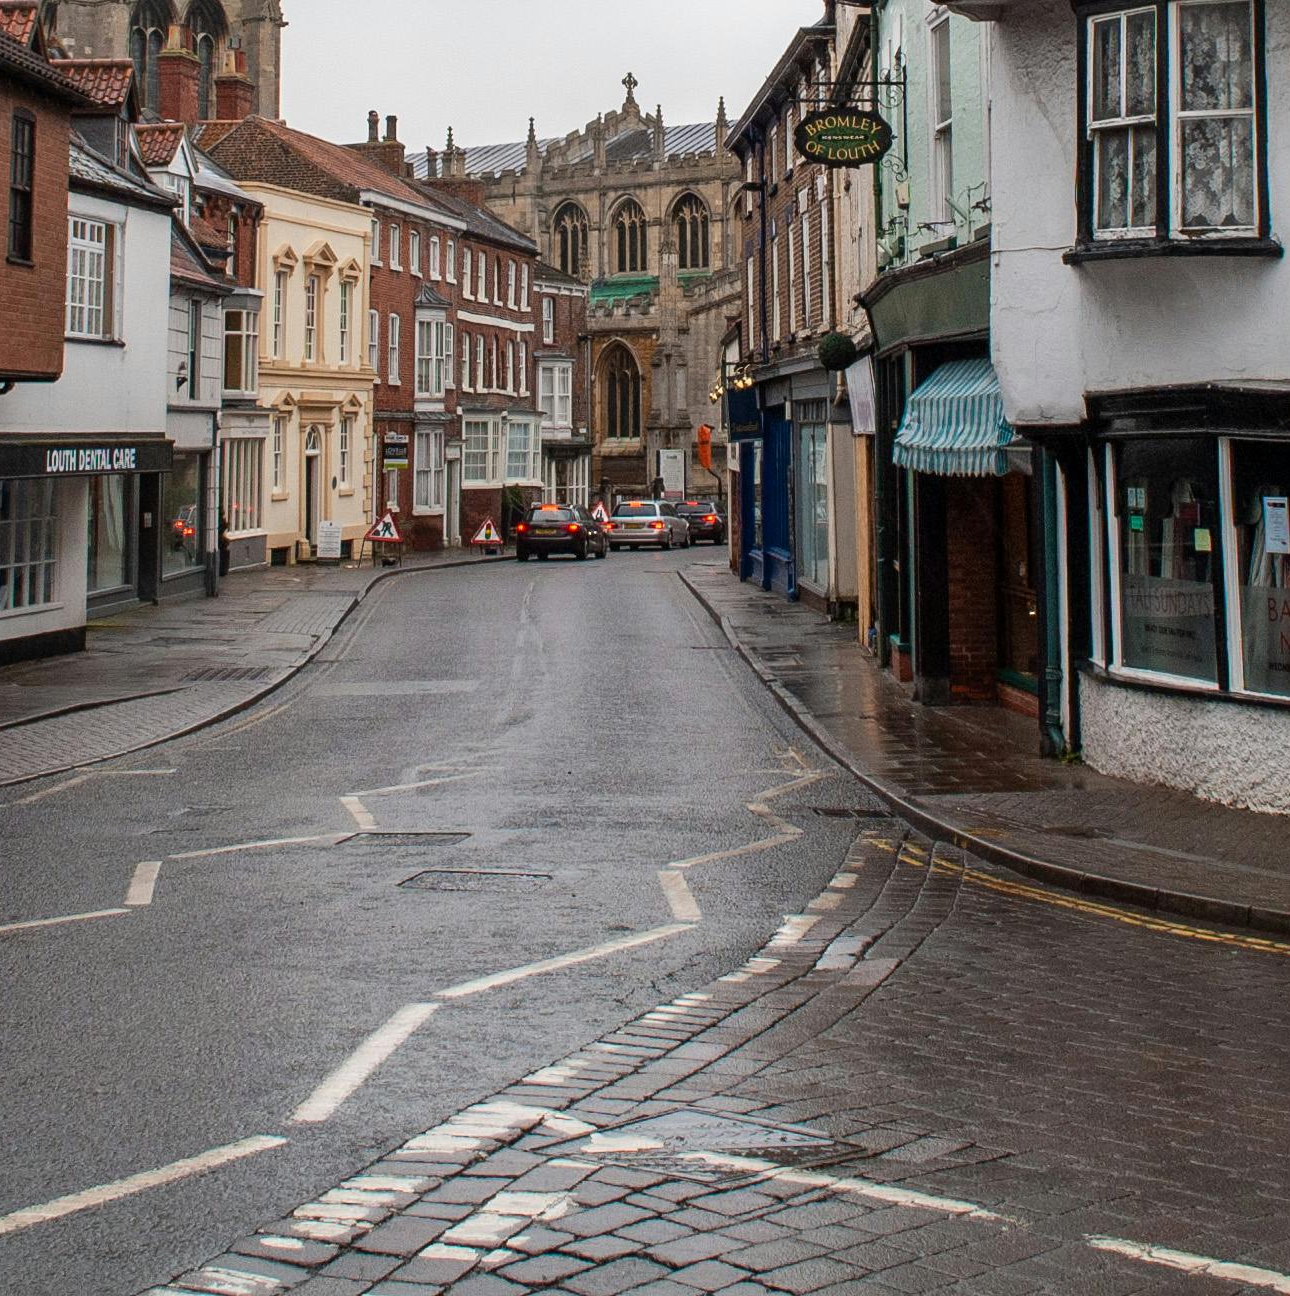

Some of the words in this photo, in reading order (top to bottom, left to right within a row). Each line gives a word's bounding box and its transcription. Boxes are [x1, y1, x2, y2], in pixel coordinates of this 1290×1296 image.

[805, 115, 882, 136] BROMLEY
[805, 140, 826, 156] OF
[827, 140, 881, 160] LOUTH
[46, 448, 77, 473] LOUTH
[78, 448, 112, 471] DENTAL
[113, 447, 136, 470] CARE
